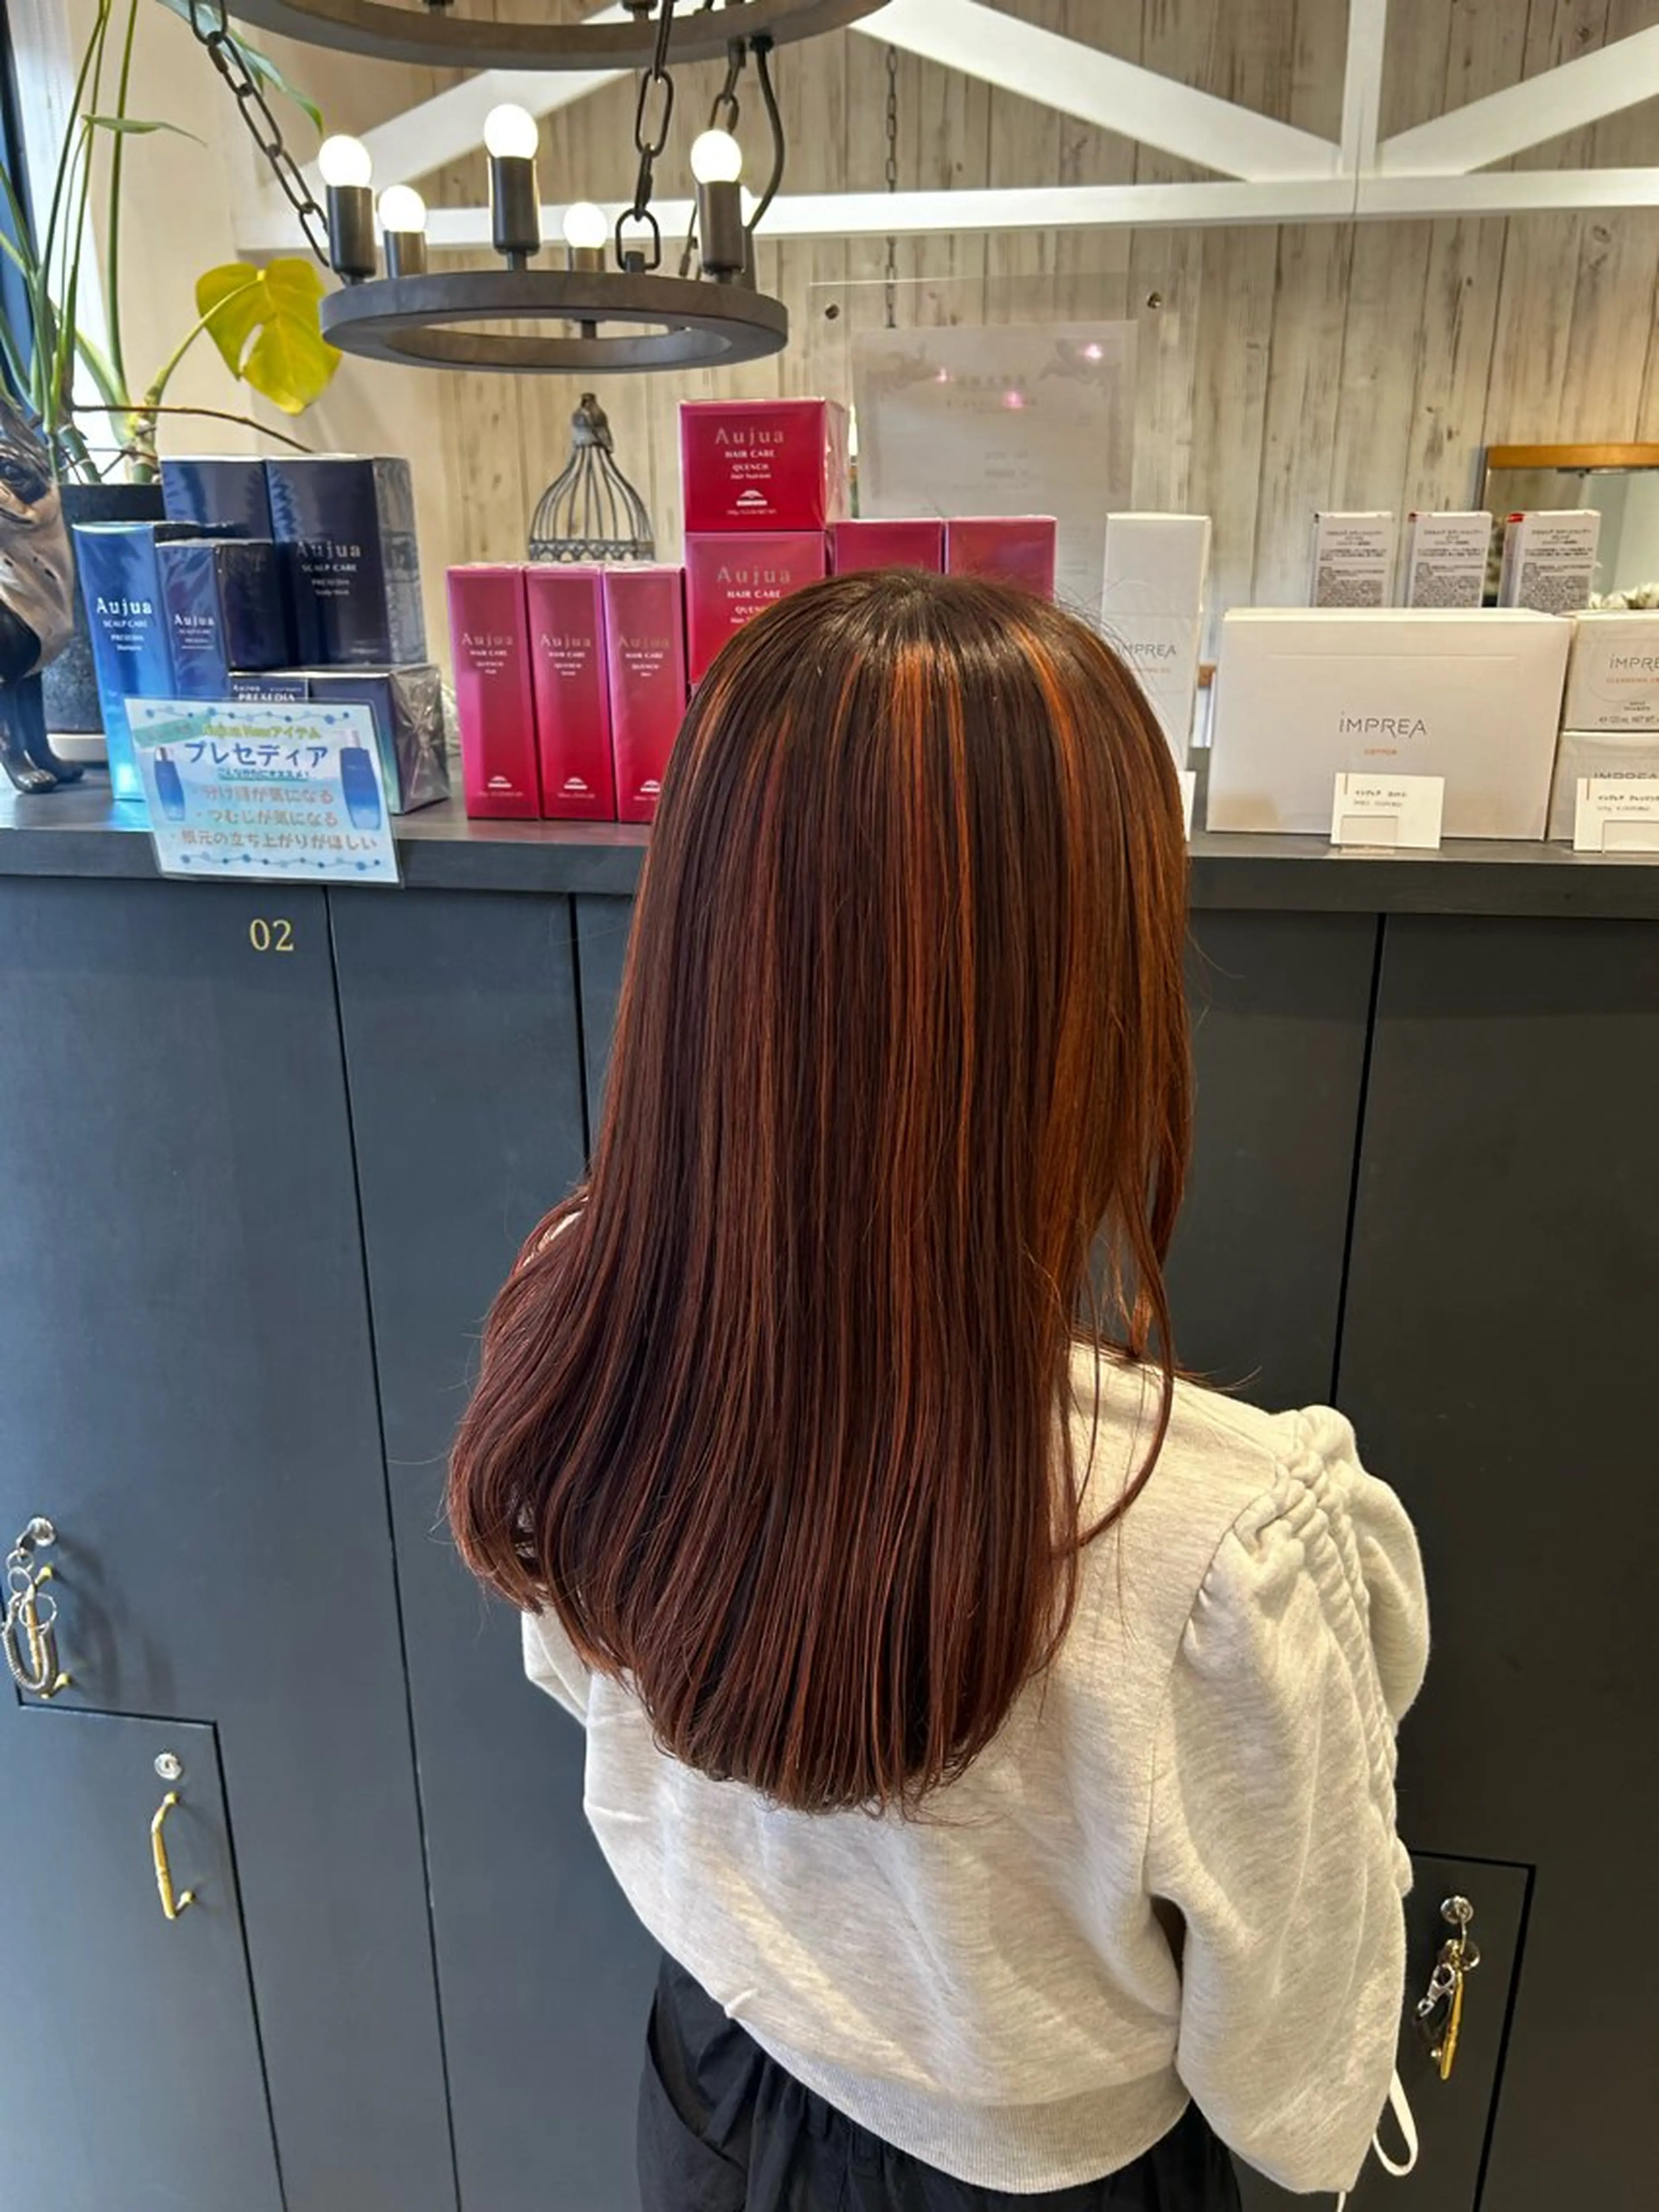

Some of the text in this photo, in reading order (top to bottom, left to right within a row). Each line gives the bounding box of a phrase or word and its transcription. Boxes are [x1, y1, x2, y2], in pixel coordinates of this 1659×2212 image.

[715, 427, 784, 446] Aujua
[750, 450, 775, 458] CARE
[297, 540, 361, 559] Aujua
[717, 565, 790, 587] Aujua
[727, 590, 780, 598] HAIR CARE
[97, 595, 152, 617] Aujua
[174, 614, 215, 627] Aujua
[461, 632, 513, 648] Aujua
[540, 633, 591, 649] Aujua
[619, 634, 669, 649] Aujua
[184, 741, 328, 768] プレセディア
[250, 918, 294, 951] 02
